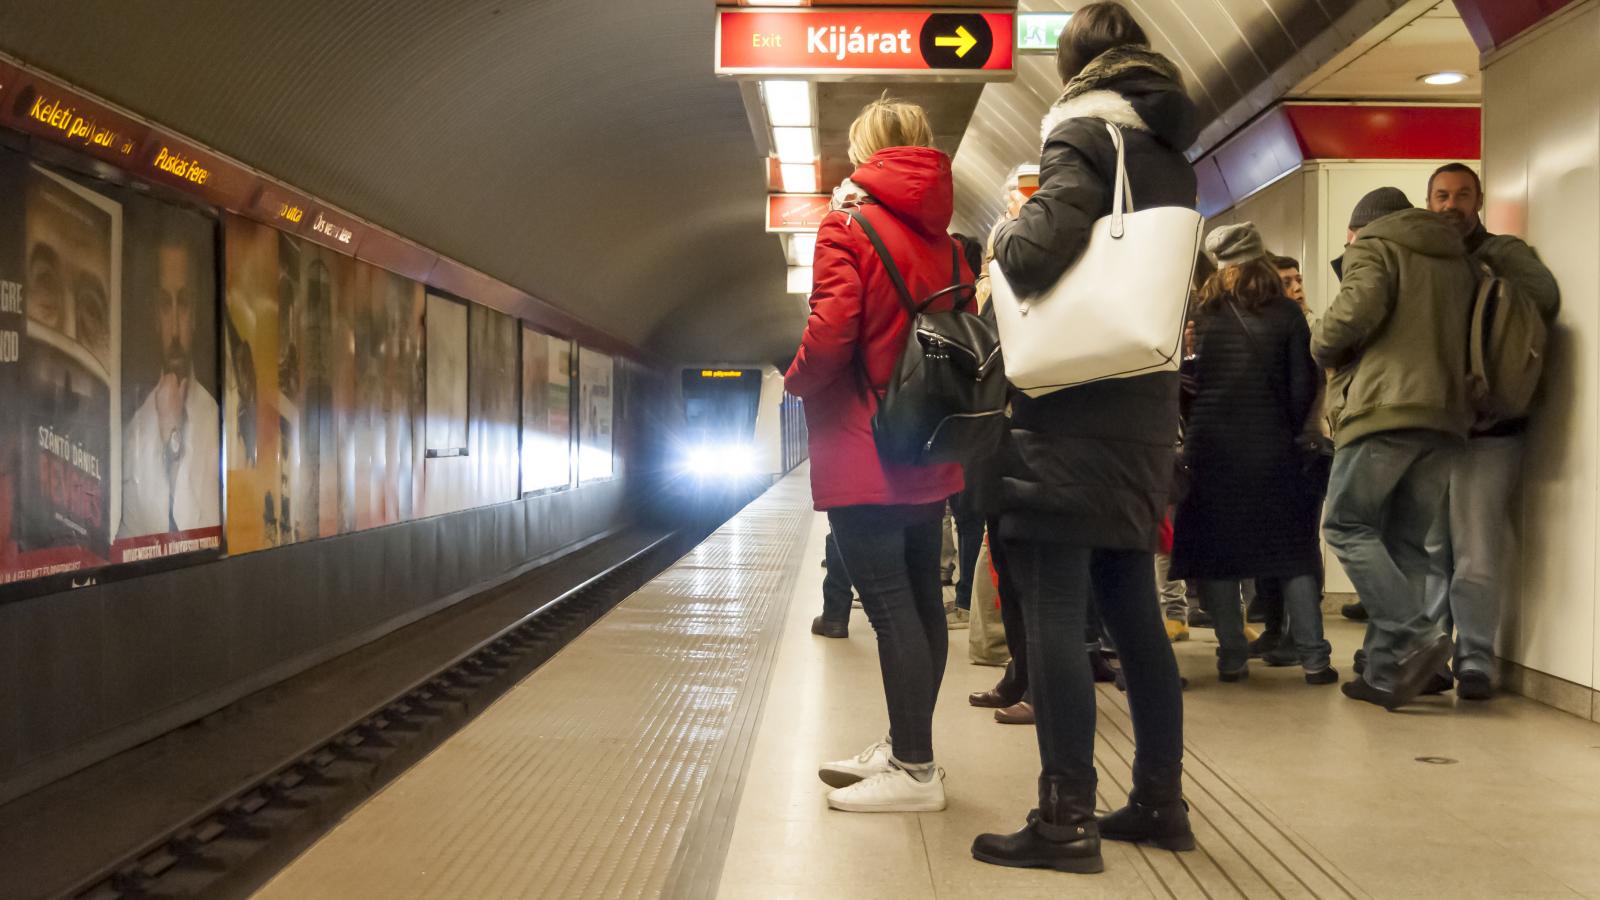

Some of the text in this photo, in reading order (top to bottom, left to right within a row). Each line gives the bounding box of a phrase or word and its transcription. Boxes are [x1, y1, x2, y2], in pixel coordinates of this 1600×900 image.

[752, 33, 782, 47] Exit
[807, 26, 911, 60] Kijárat
[31, 96, 75, 130] Keleti
[154, 147, 189, 177] Puskás
[39, 425, 101, 480] SZÁNTÓ DÁNIEL
